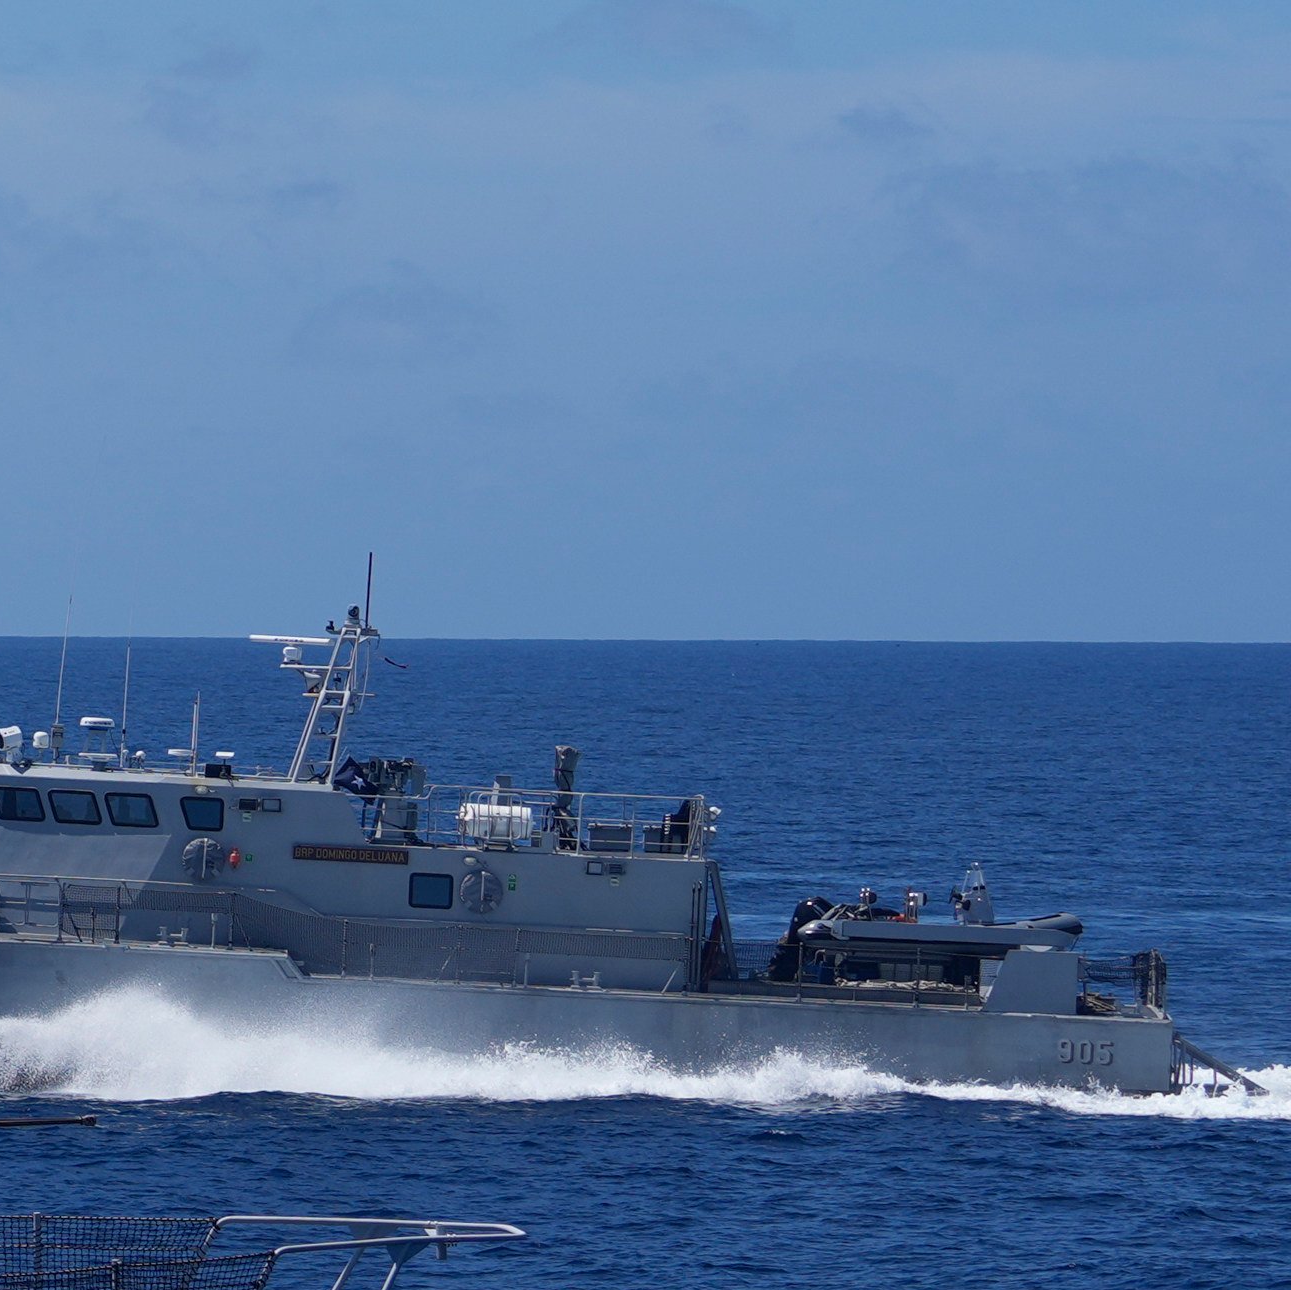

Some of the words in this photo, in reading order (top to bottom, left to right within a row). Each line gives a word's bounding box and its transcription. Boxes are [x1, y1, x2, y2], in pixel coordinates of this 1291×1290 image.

[295, 847, 314, 858] BRP
[316, 848, 357, 860] DOMINGO
[359, 850, 405, 862] DELUANA
[1059, 1039, 1114, 1066] 905
